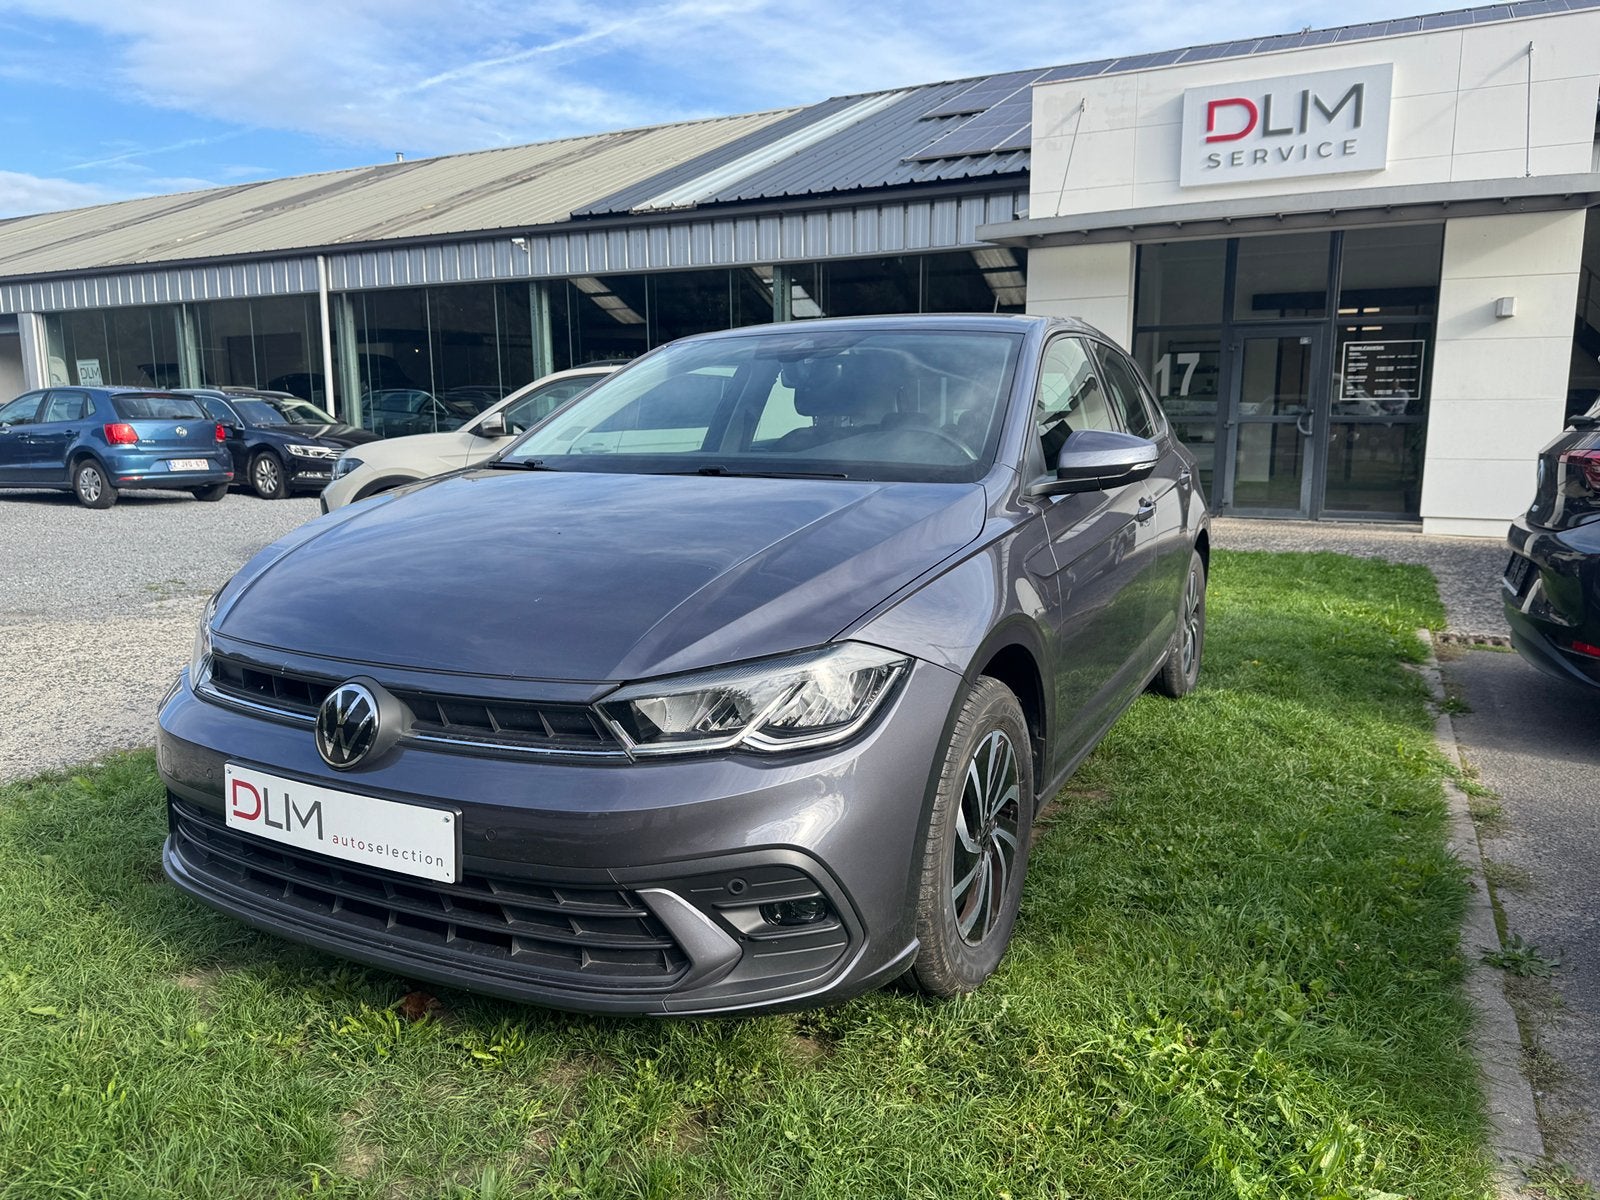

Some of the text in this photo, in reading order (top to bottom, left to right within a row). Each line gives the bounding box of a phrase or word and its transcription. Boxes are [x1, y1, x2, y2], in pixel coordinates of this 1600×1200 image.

[1205, 82, 1364, 143] DLM
[1206, 138, 1358, 169] SERVICE
[1153, 352, 1201, 397] 17
[231, 778, 445, 868] DLM autoselection
